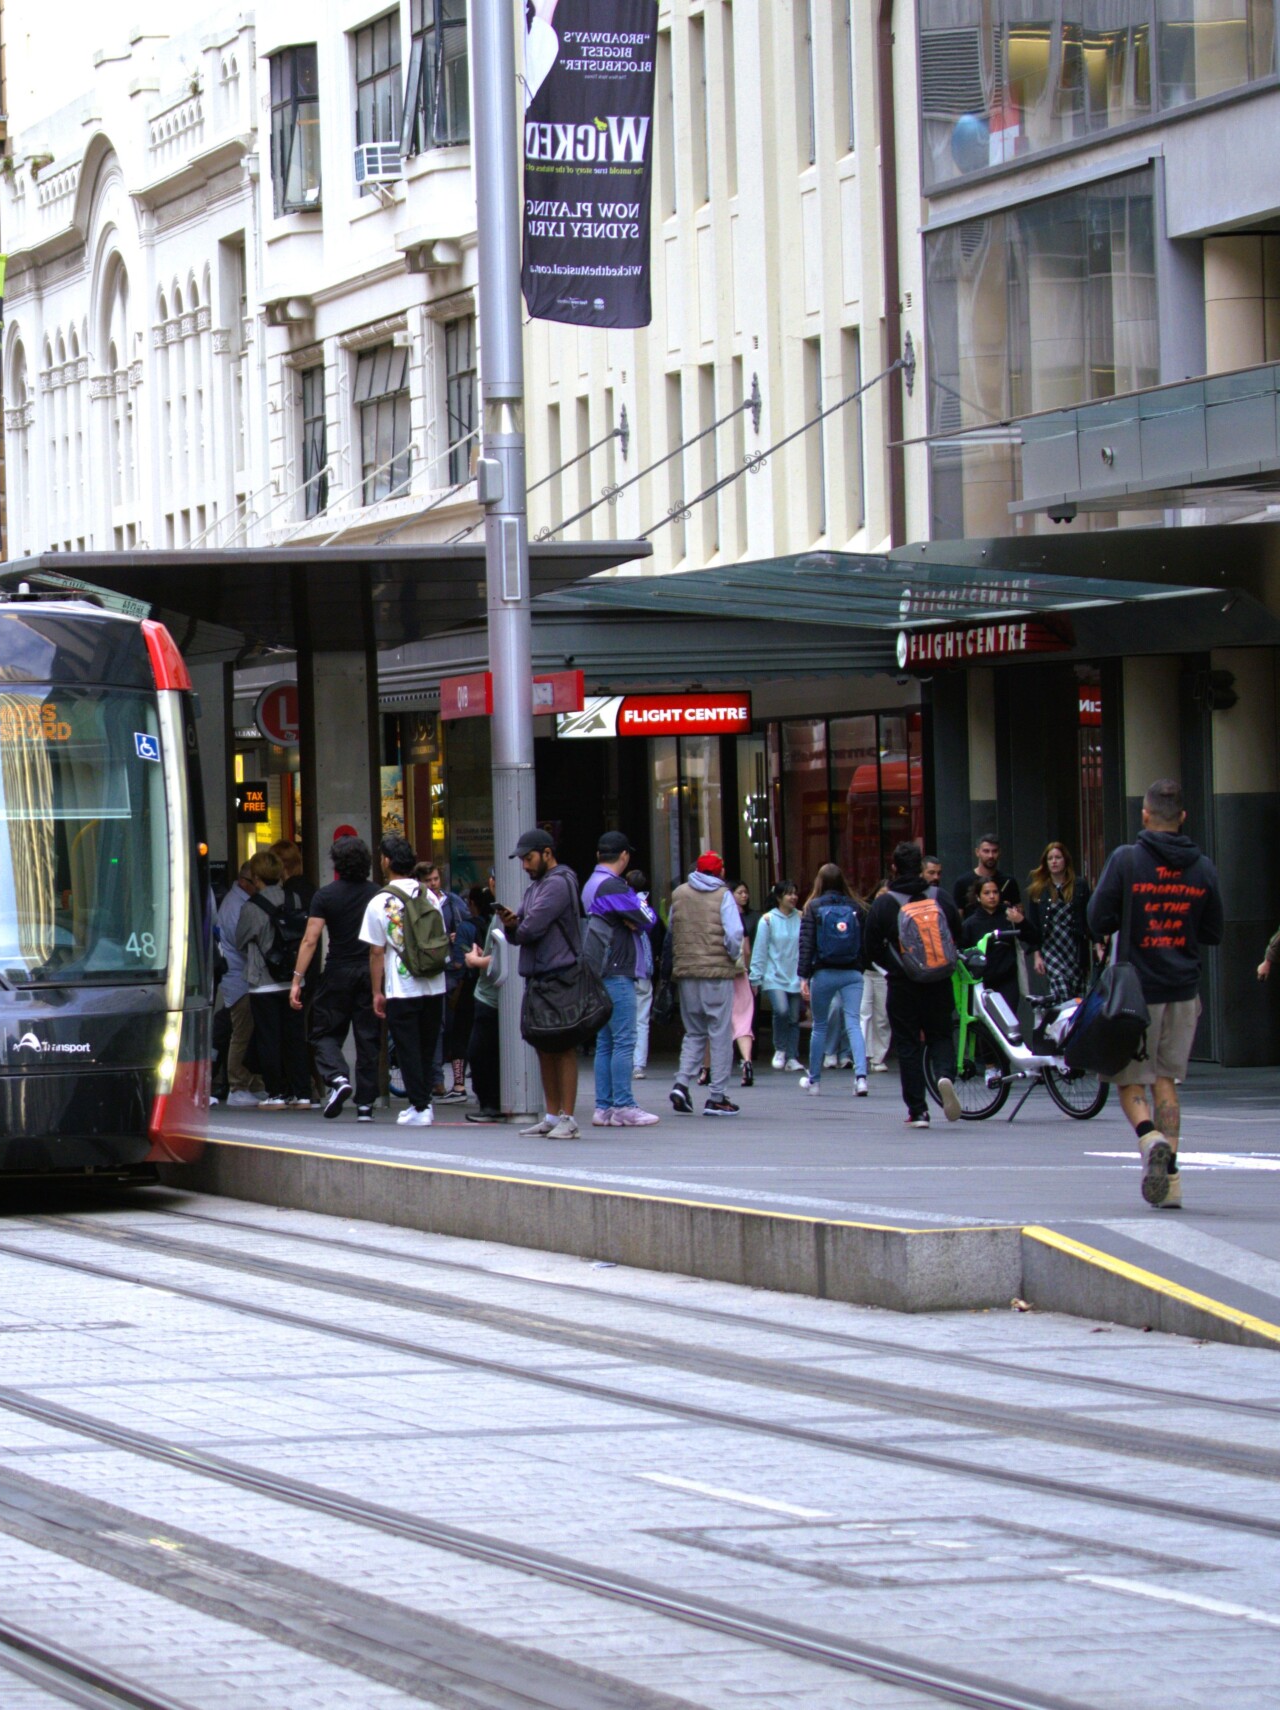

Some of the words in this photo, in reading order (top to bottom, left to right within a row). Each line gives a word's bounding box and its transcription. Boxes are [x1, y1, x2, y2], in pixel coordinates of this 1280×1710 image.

[624, 708, 682, 722] FLIGHT
[684, 707, 747, 721] CENTRE
[246, 791, 263, 801] TAX
[243, 803, 266, 812] FREE
[1163, 902, 1191, 914] THE
[126, 932, 157, 958] 48
[41, 1041, 91, 1053] Transport
